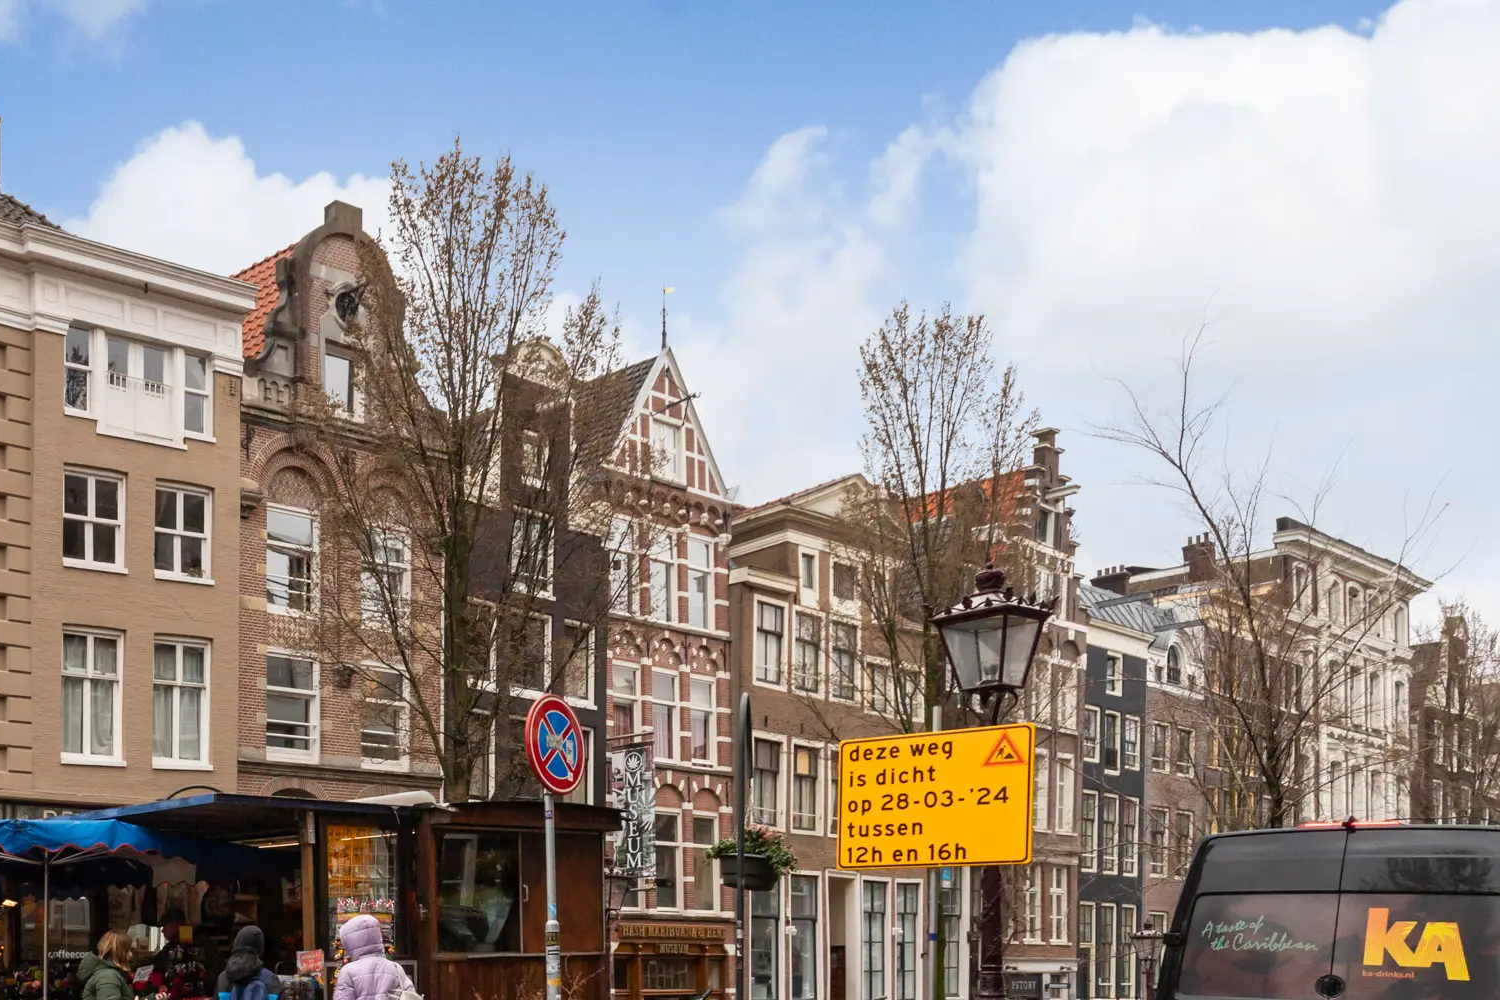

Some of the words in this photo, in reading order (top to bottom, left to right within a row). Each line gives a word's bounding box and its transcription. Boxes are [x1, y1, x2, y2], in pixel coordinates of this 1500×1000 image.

[850, 746, 900, 762] deze
[910, 741, 953, 760] weg
[850, 772, 866, 788] is
[876, 765, 936, 786] dicht
[848, 799, 872, 816] op
[881, 786, 1009, 812] 28-03-'24
[625, 771, 642, 869] MUSEUM
[847, 822, 923, 838] tussen
[847, 846, 882, 864] 12h
[892, 849, 918, 862] en
[929, 843, 967, 861] 16h
[1232, 931, 1319, 951] Caribbean
